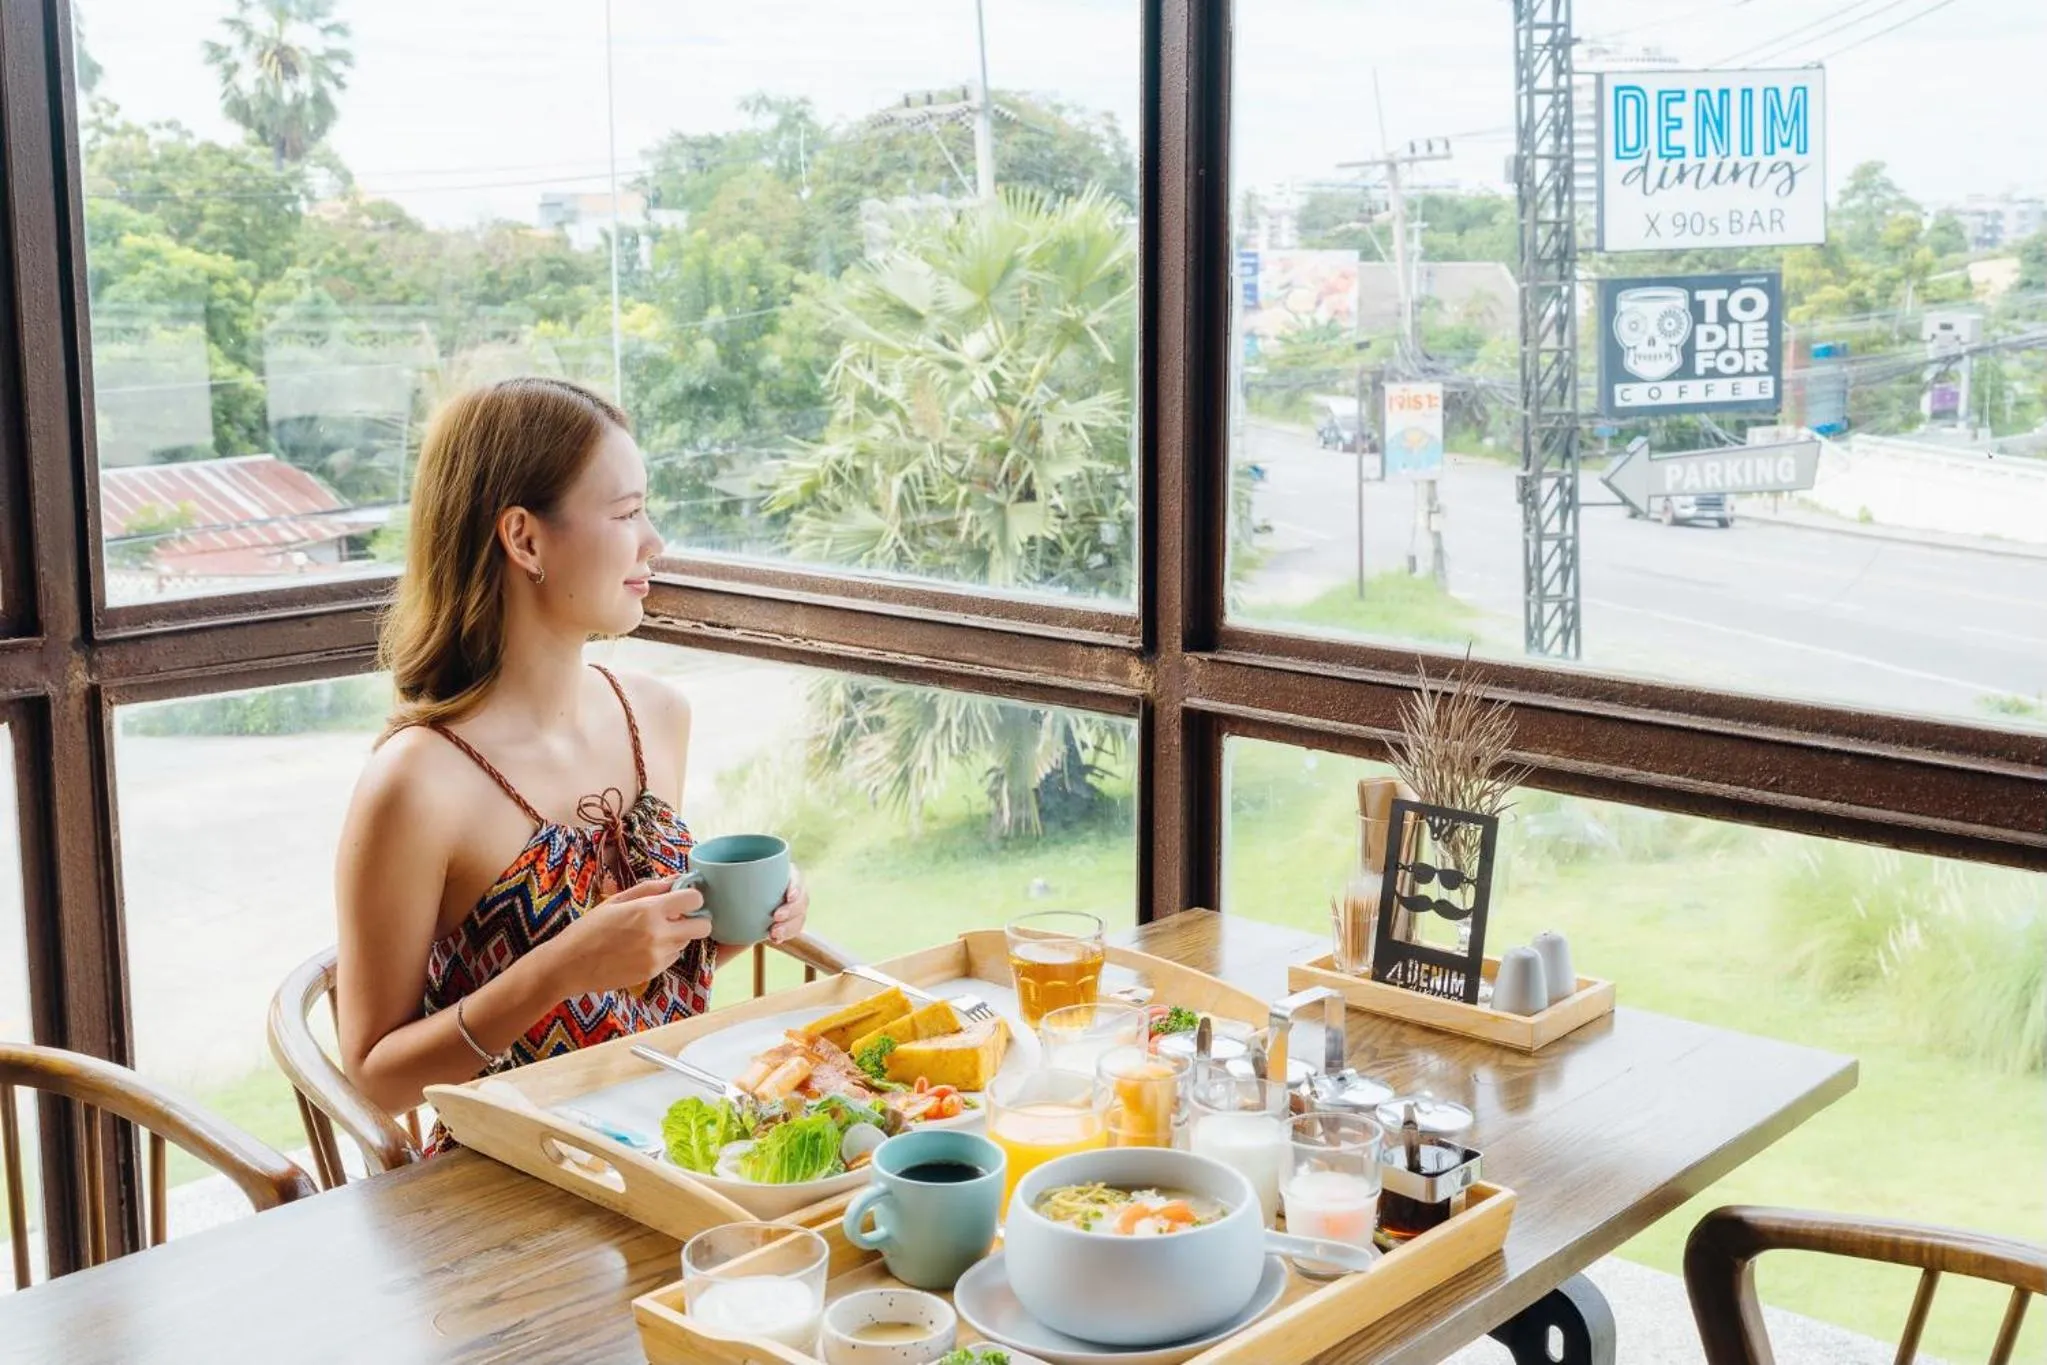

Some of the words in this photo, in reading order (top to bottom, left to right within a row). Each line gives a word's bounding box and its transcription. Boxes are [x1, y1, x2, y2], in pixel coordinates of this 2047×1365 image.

[1614, 85, 1808, 160] DENIM
[1621, 149, 1811, 196] dining
[1644, 212, 1662, 238] X
[1672, 211, 1720, 237] 90s
[1728, 208, 1786, 235] BAR
[1694, 287, 1769, 323] TO
[1695, 321, 1769, 350] DIE
[1694, 349, 1768, 376] FOR
[1619, 380, 1769, 402] COFFEE
[1664, 456, 1796, 492] PARKING
[1407, 958, 1467, 997] DENIM
